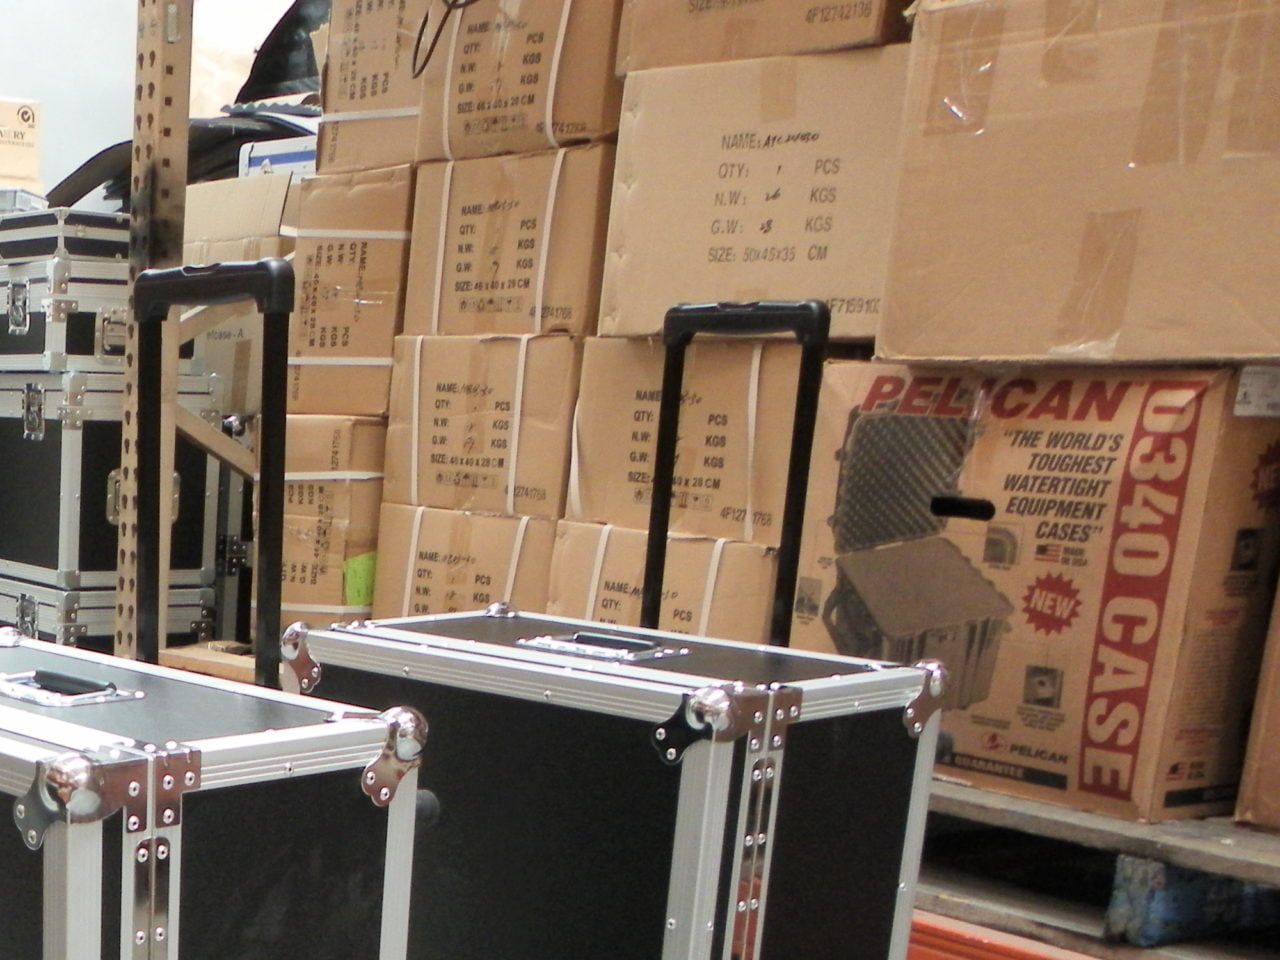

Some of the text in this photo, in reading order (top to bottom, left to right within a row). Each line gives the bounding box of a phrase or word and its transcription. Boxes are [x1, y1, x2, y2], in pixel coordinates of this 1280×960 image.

[721, 133, 761, 150] NAME:
[718, 163, 749, 179] QTY:
[814, 158, 841, 174] PCS
[809, 187, 837, 203] KGS
[520, 218, 537, 230] PCS
[805, 216, 832, 232] KGS
[517, 239, 535, 250] KGS
[708, 247, 736, 263] SIZE:
[807, 246, 828, 261] CM
[516, 258, 533, 270] KGS
[495, 401, 511, 411] PCS
[859, 375, 1133, 422] PELICAN
[492, 420, 509, 431] KGS
[708, 414, 727, 426] PCS
[491, 439, 508, 449] KGS
[705, 435, 726, 447] KGS
[1046, 431, 1125, 452] WORLD'S
[703, 456, 724, 469] KGS
[1027, 453, 1117, 476] TOUGHEST
[1003, 475, 1112, 499] WATERTIGHT
[720, 506, 773, 527] 4F1271768
[1004, 497, 1108, 521] EQUIPMENT
[475, 574, 491, 586] PCS
[473, 592, 490, 603] KGS
[1030, 587, 1076, 619] NEW
[673, 609, 693, 622] PCS
[1083, 595, 1159, 792] CASE
[1009, 744, 1069, 764] PELICAN
